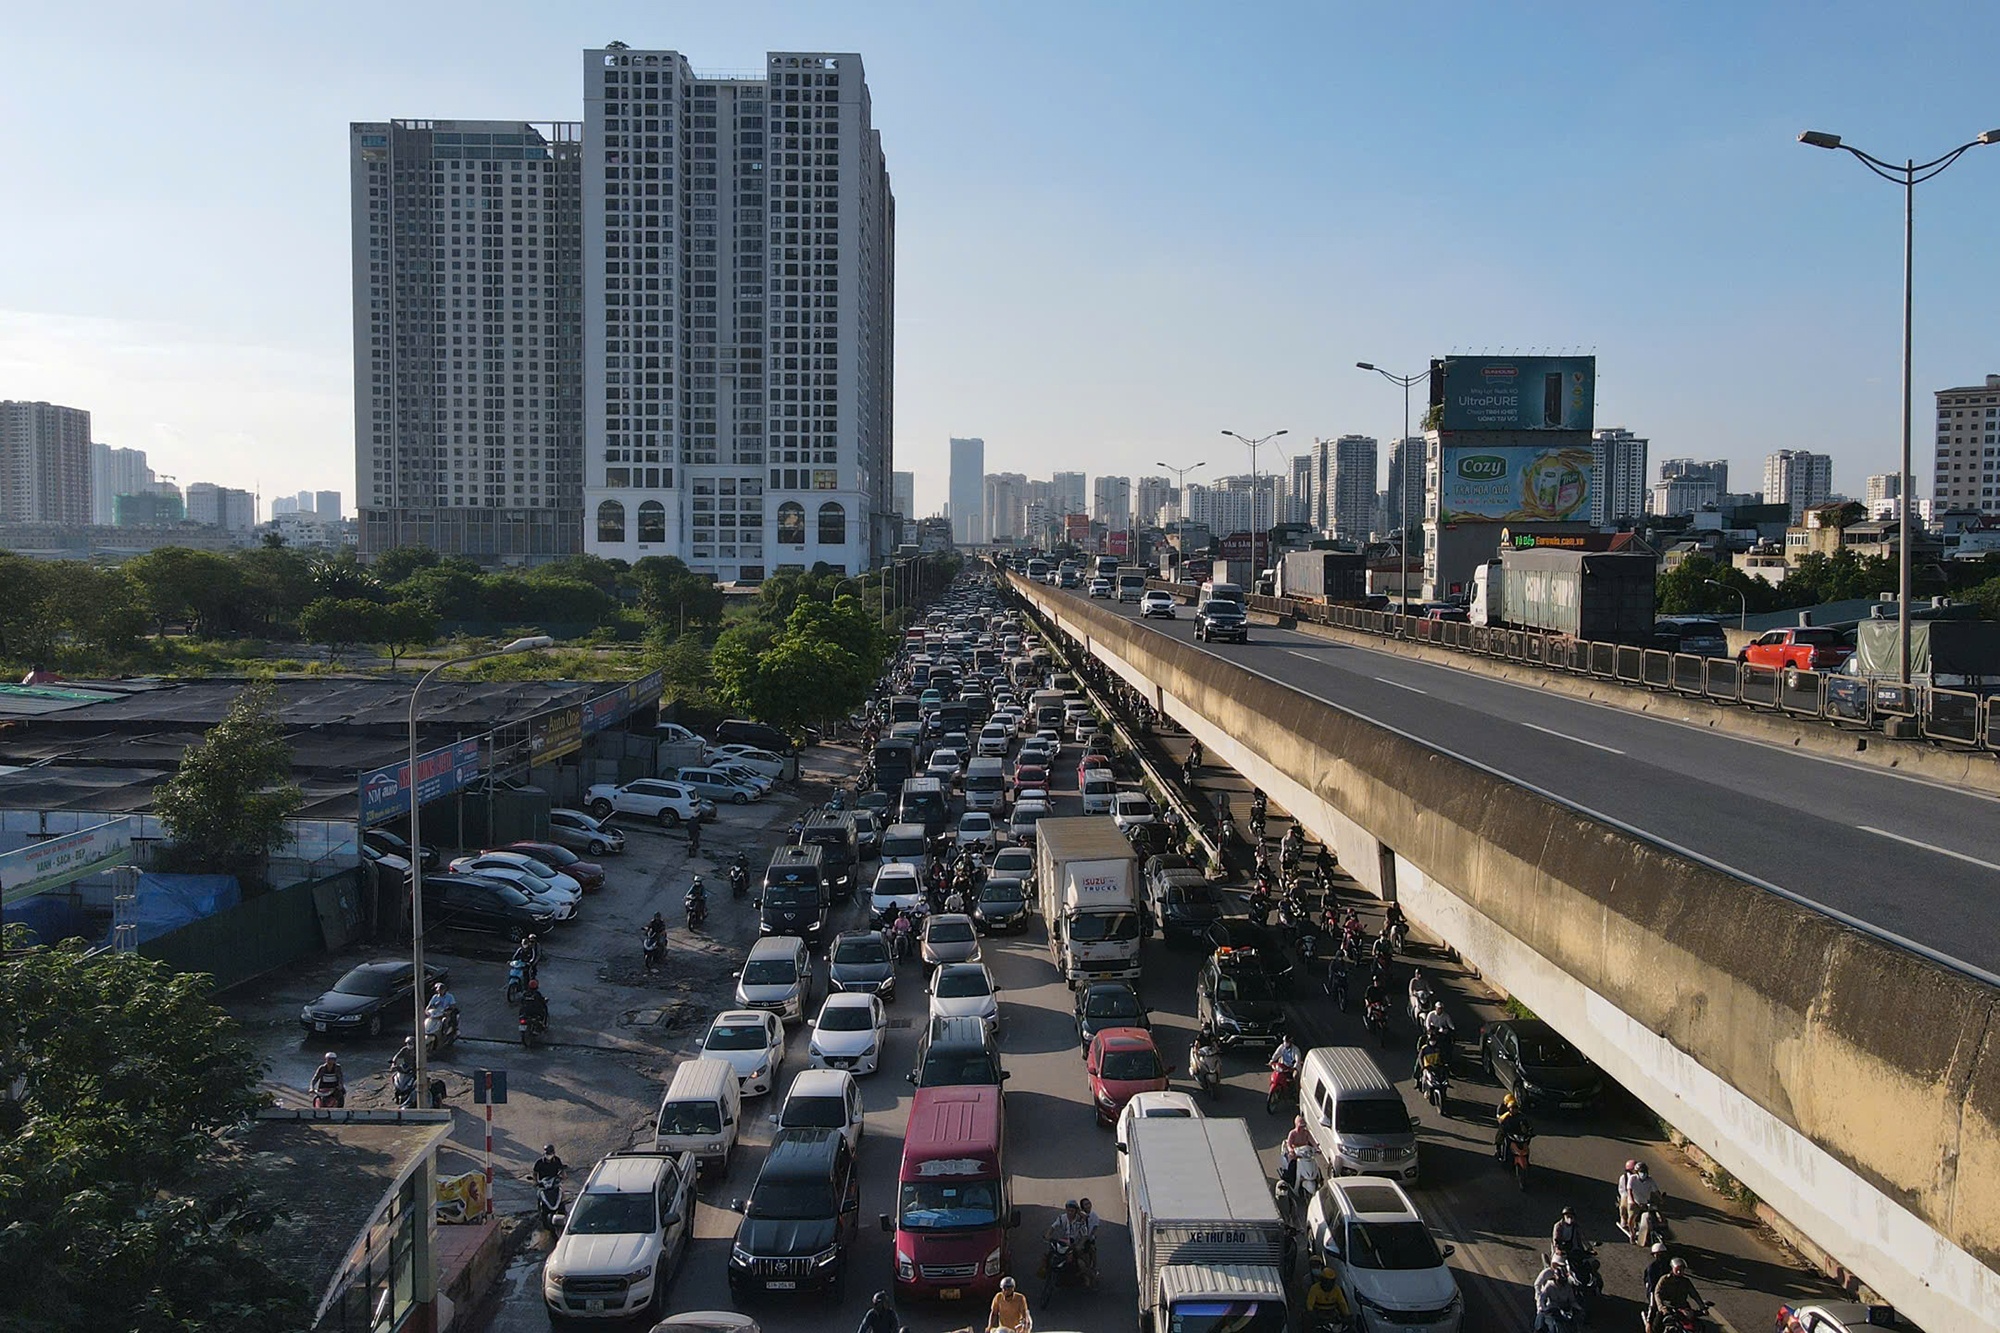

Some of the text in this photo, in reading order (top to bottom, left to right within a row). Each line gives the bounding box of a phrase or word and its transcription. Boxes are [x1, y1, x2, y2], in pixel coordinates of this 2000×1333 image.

[1458, 396, 1518, 406] UltraPURE
[1462, 459, 1501, 476] Cozy
[549, 716, 566, 733] Auto
[566, 709, 580, 727] One
[382, 784, 398, 798] auto
[1082, 877, 1106, 886] ISUZU
[1190, 1231, 1202, 1243] XE
